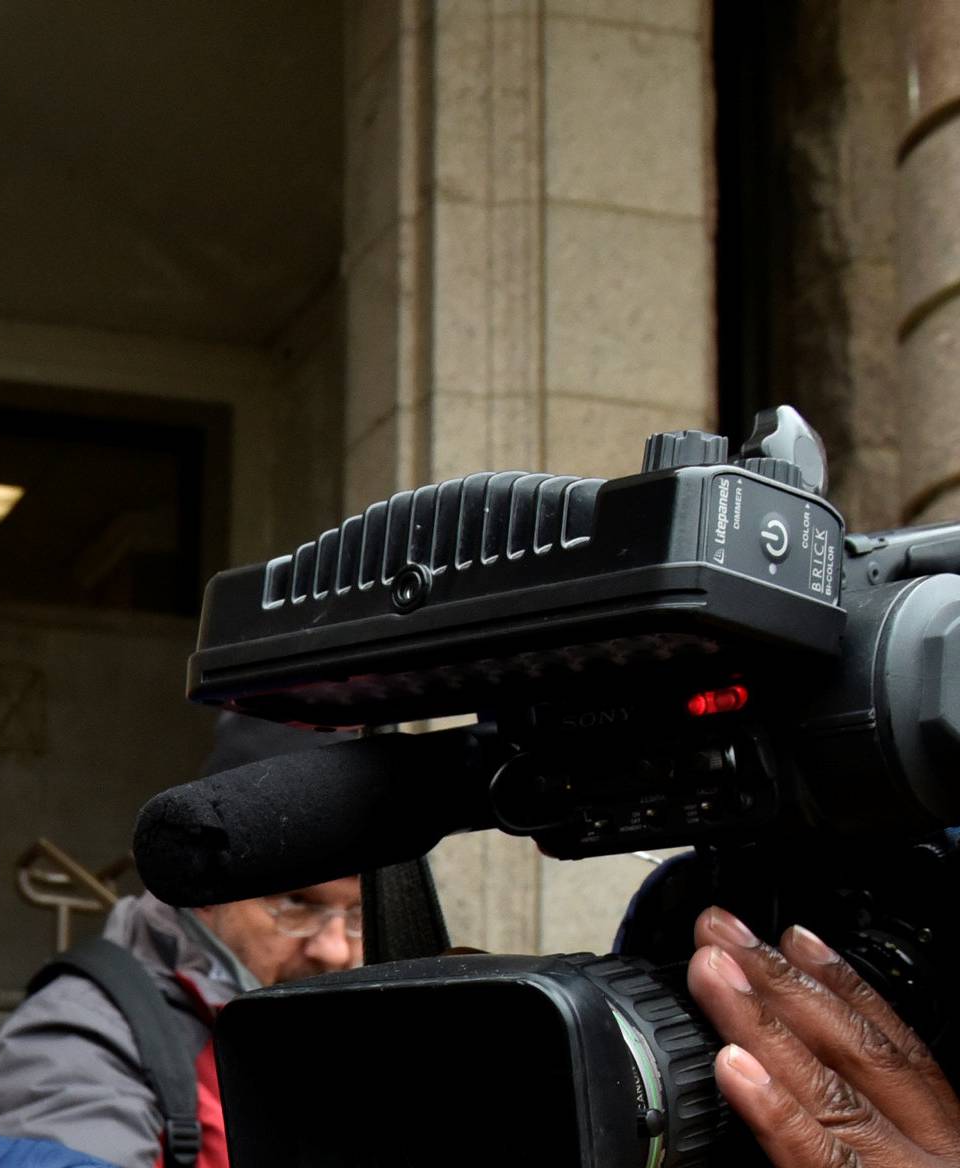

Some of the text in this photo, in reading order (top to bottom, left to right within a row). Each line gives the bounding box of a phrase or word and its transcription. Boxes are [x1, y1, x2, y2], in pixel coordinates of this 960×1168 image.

[714, 477, 729, 544] Litepanels
[733, 487, 742, 530] DIMMER
[802, 511, 811, 549] COLOR
[812, 528, 825, 592] BRICK
[825, 546, 835, 596] BI-COLOR
[562, 706, 635, 728] SONY
